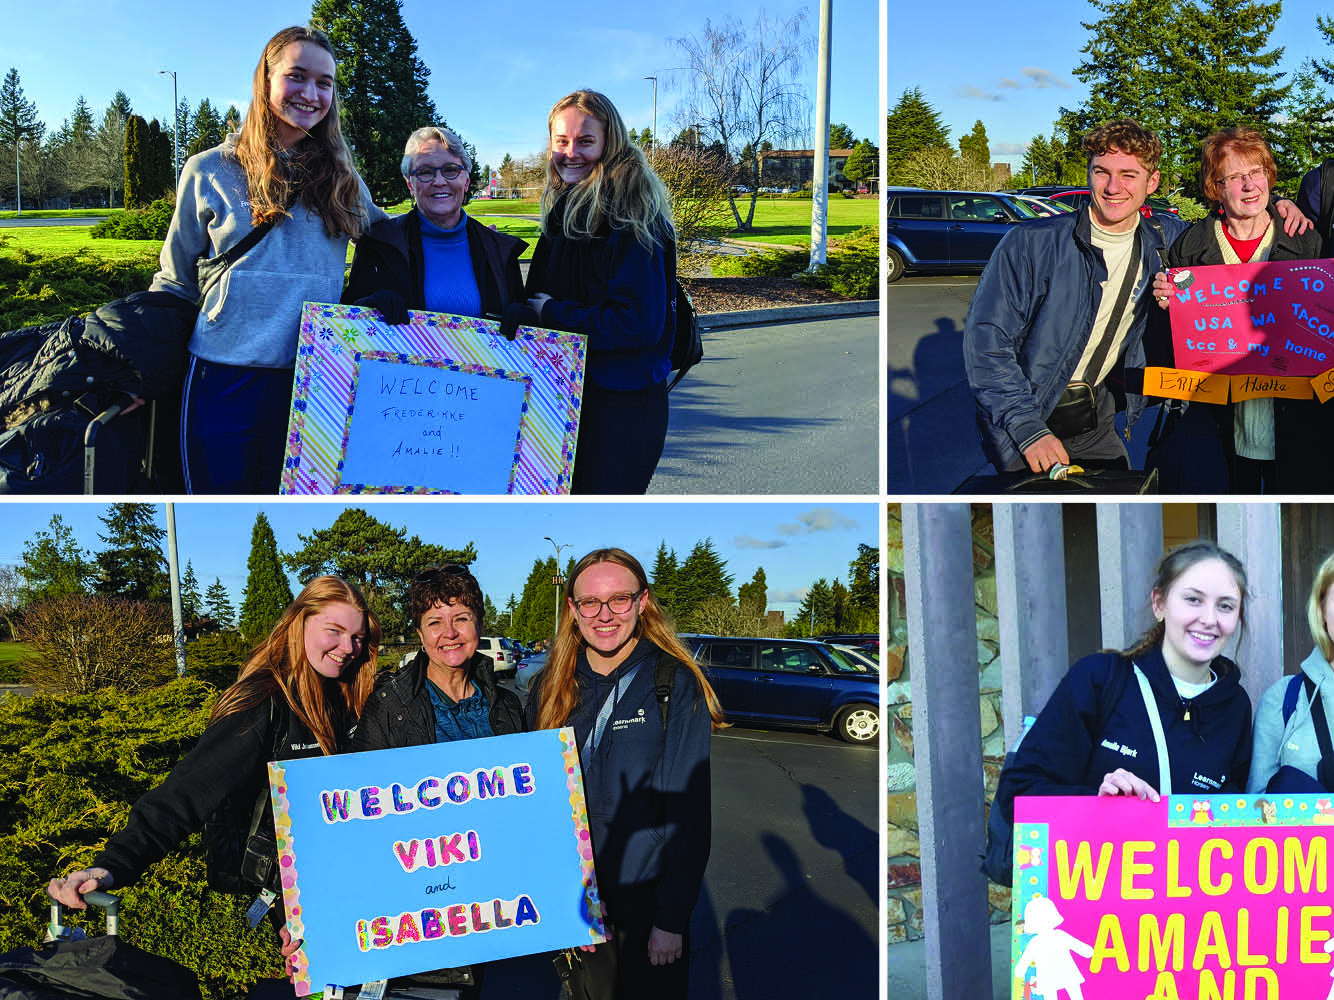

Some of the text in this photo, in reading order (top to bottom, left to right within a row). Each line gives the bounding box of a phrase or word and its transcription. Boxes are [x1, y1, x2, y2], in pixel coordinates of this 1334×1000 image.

[1176, 277, 1325, 304] WELCOME TO
[1194, 317, 1233, 332] USA
[1251, 312, 1276, 328] WA
[1186, 338, 1327, 362] tcc & my home
[380, 375, 480, 401] WELCOME
[422, 425, 442, 440] and
[321, 765, 533, 822] WELCOME
[395, 831, 479, 870] VIKI
[425, 876, 456, 894] and
[358, 896, 540, 952] ISABELLA
[1089, 905, 1333, 973] AMALIE
